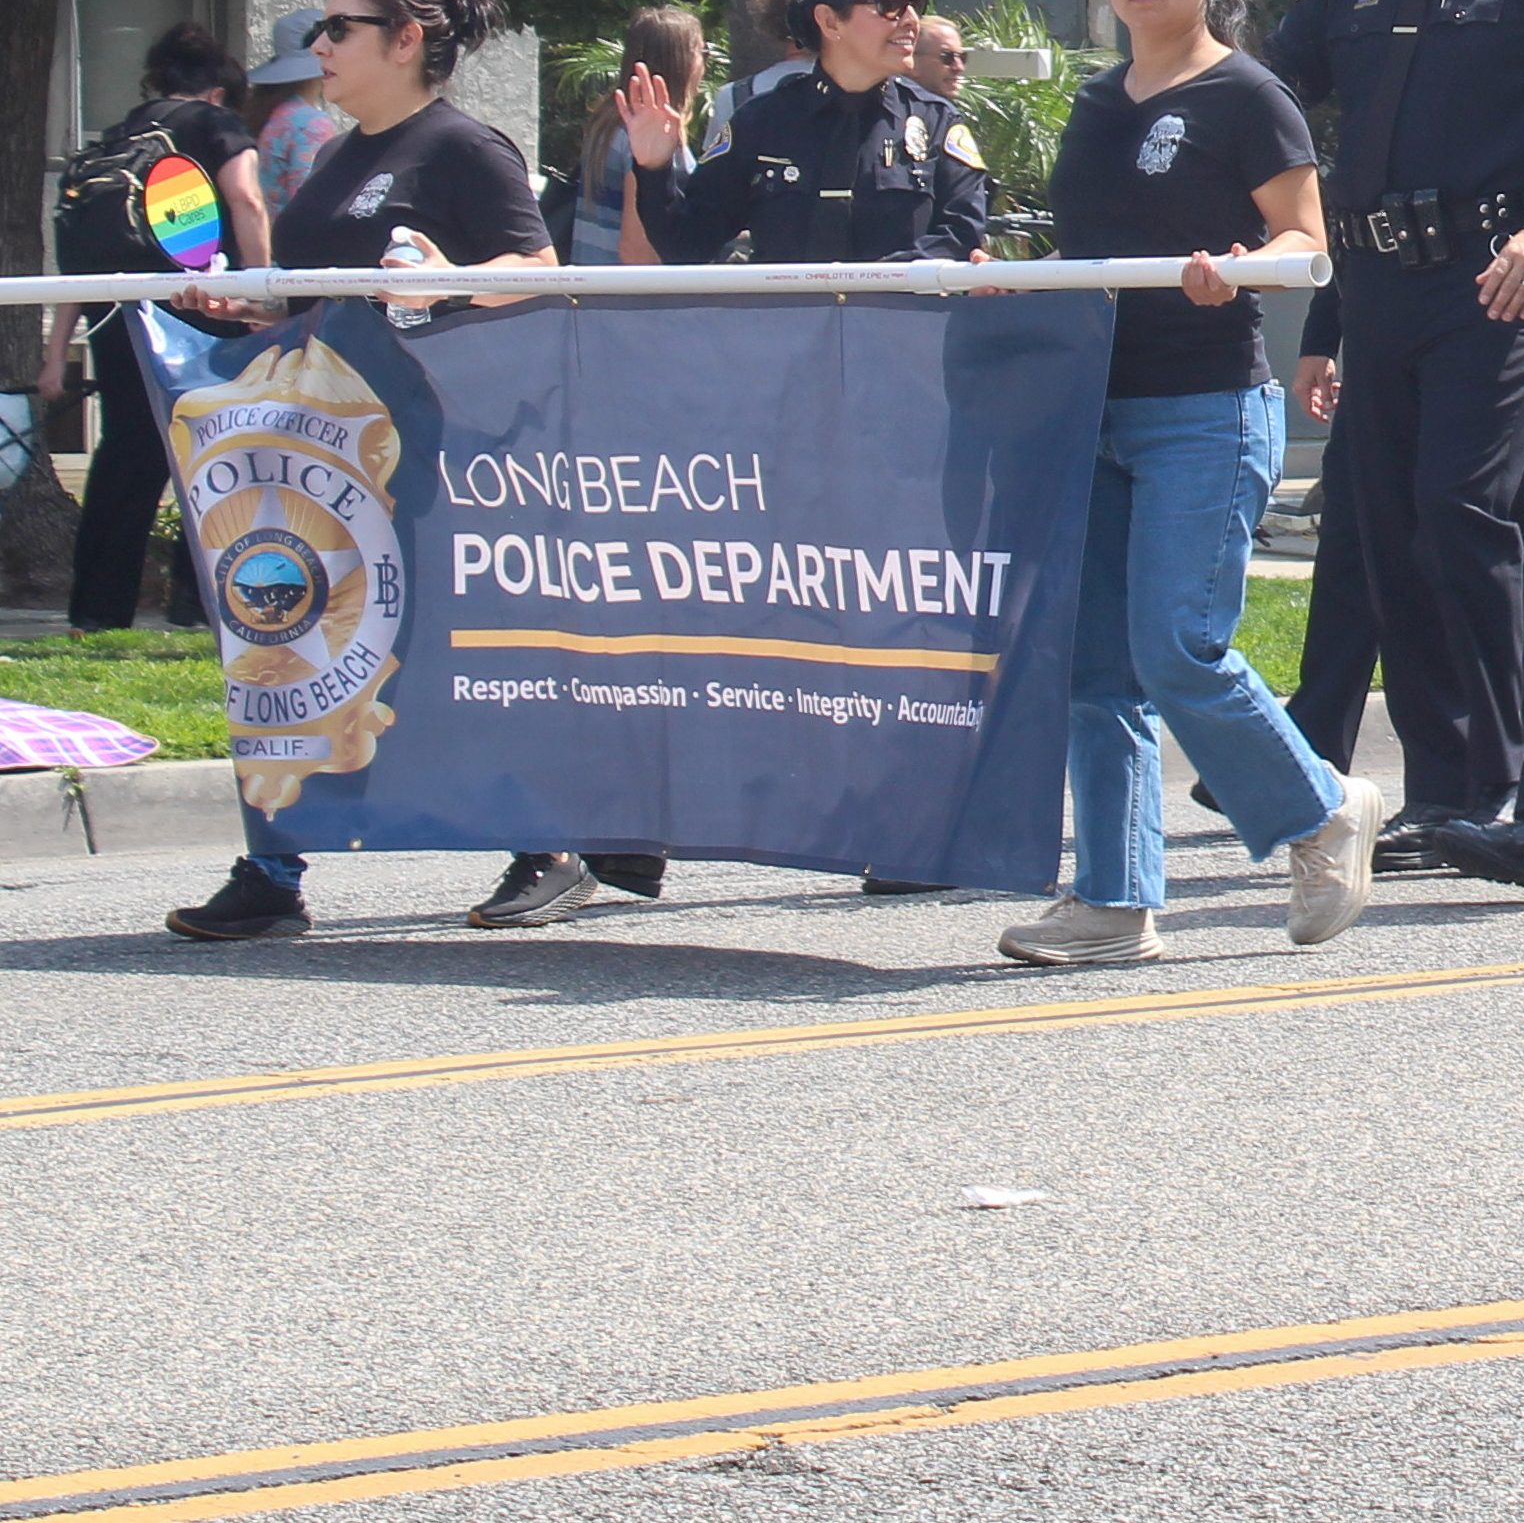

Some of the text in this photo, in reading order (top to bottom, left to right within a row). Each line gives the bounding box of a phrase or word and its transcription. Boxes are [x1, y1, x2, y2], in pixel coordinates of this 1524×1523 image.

[173, 193, 200, 214] LBPD
[805, 272, 855, 281] CHARLOTTE
[859, 272, 882, 280] PIPE
[196, 407, 348, 450] POLICE OFFICER
[188, 452, 366, 522] POLICE
[439, 450, 766, 513] LONG BEACH
[235, 537, 251, 552] OF
[453, 533, 1012, 617] POLICE DEPARTMENT
[243, 688, 307, 724] LONG
[309, 641, 381, 712] BEACH
[453, 675, 559, 708] Respect
[706, 681, 785, 711] Service
[796, 687, 882, 726] Integrity
[235, 739, 308, 756] CALIF.
